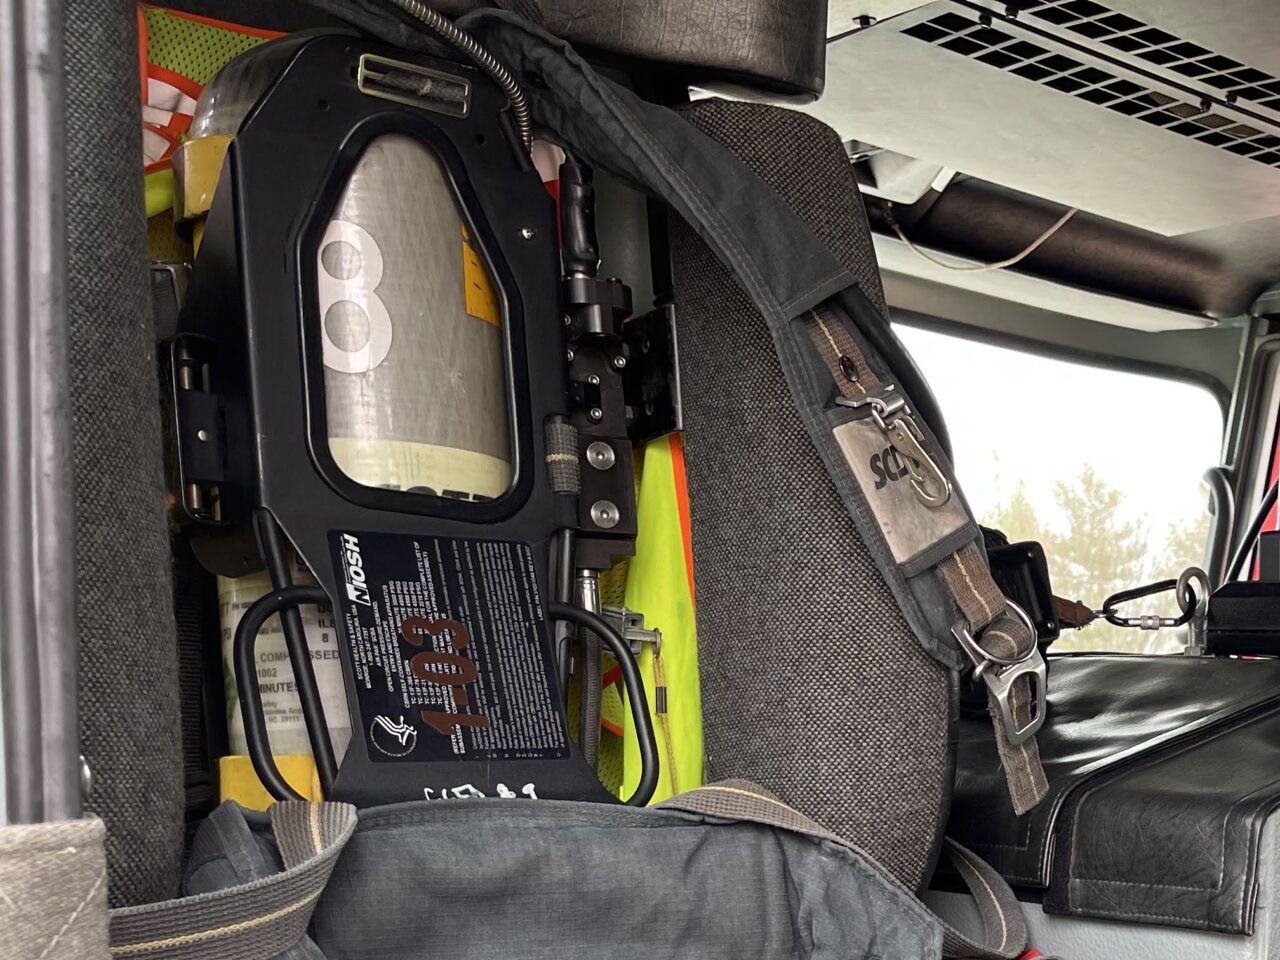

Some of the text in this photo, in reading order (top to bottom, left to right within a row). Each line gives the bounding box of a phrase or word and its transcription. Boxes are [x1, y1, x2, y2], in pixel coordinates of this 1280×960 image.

[343, 533, 371, 606] NIOSH
[346, 613, 355, 634] SAFETY
[382, 620, 391, 641] ESCAPE
[351, 639, 360, 661] HEALTH
[355, 662, 364, 680] SCOTT
[401, 617, 490, 735] 1-03
